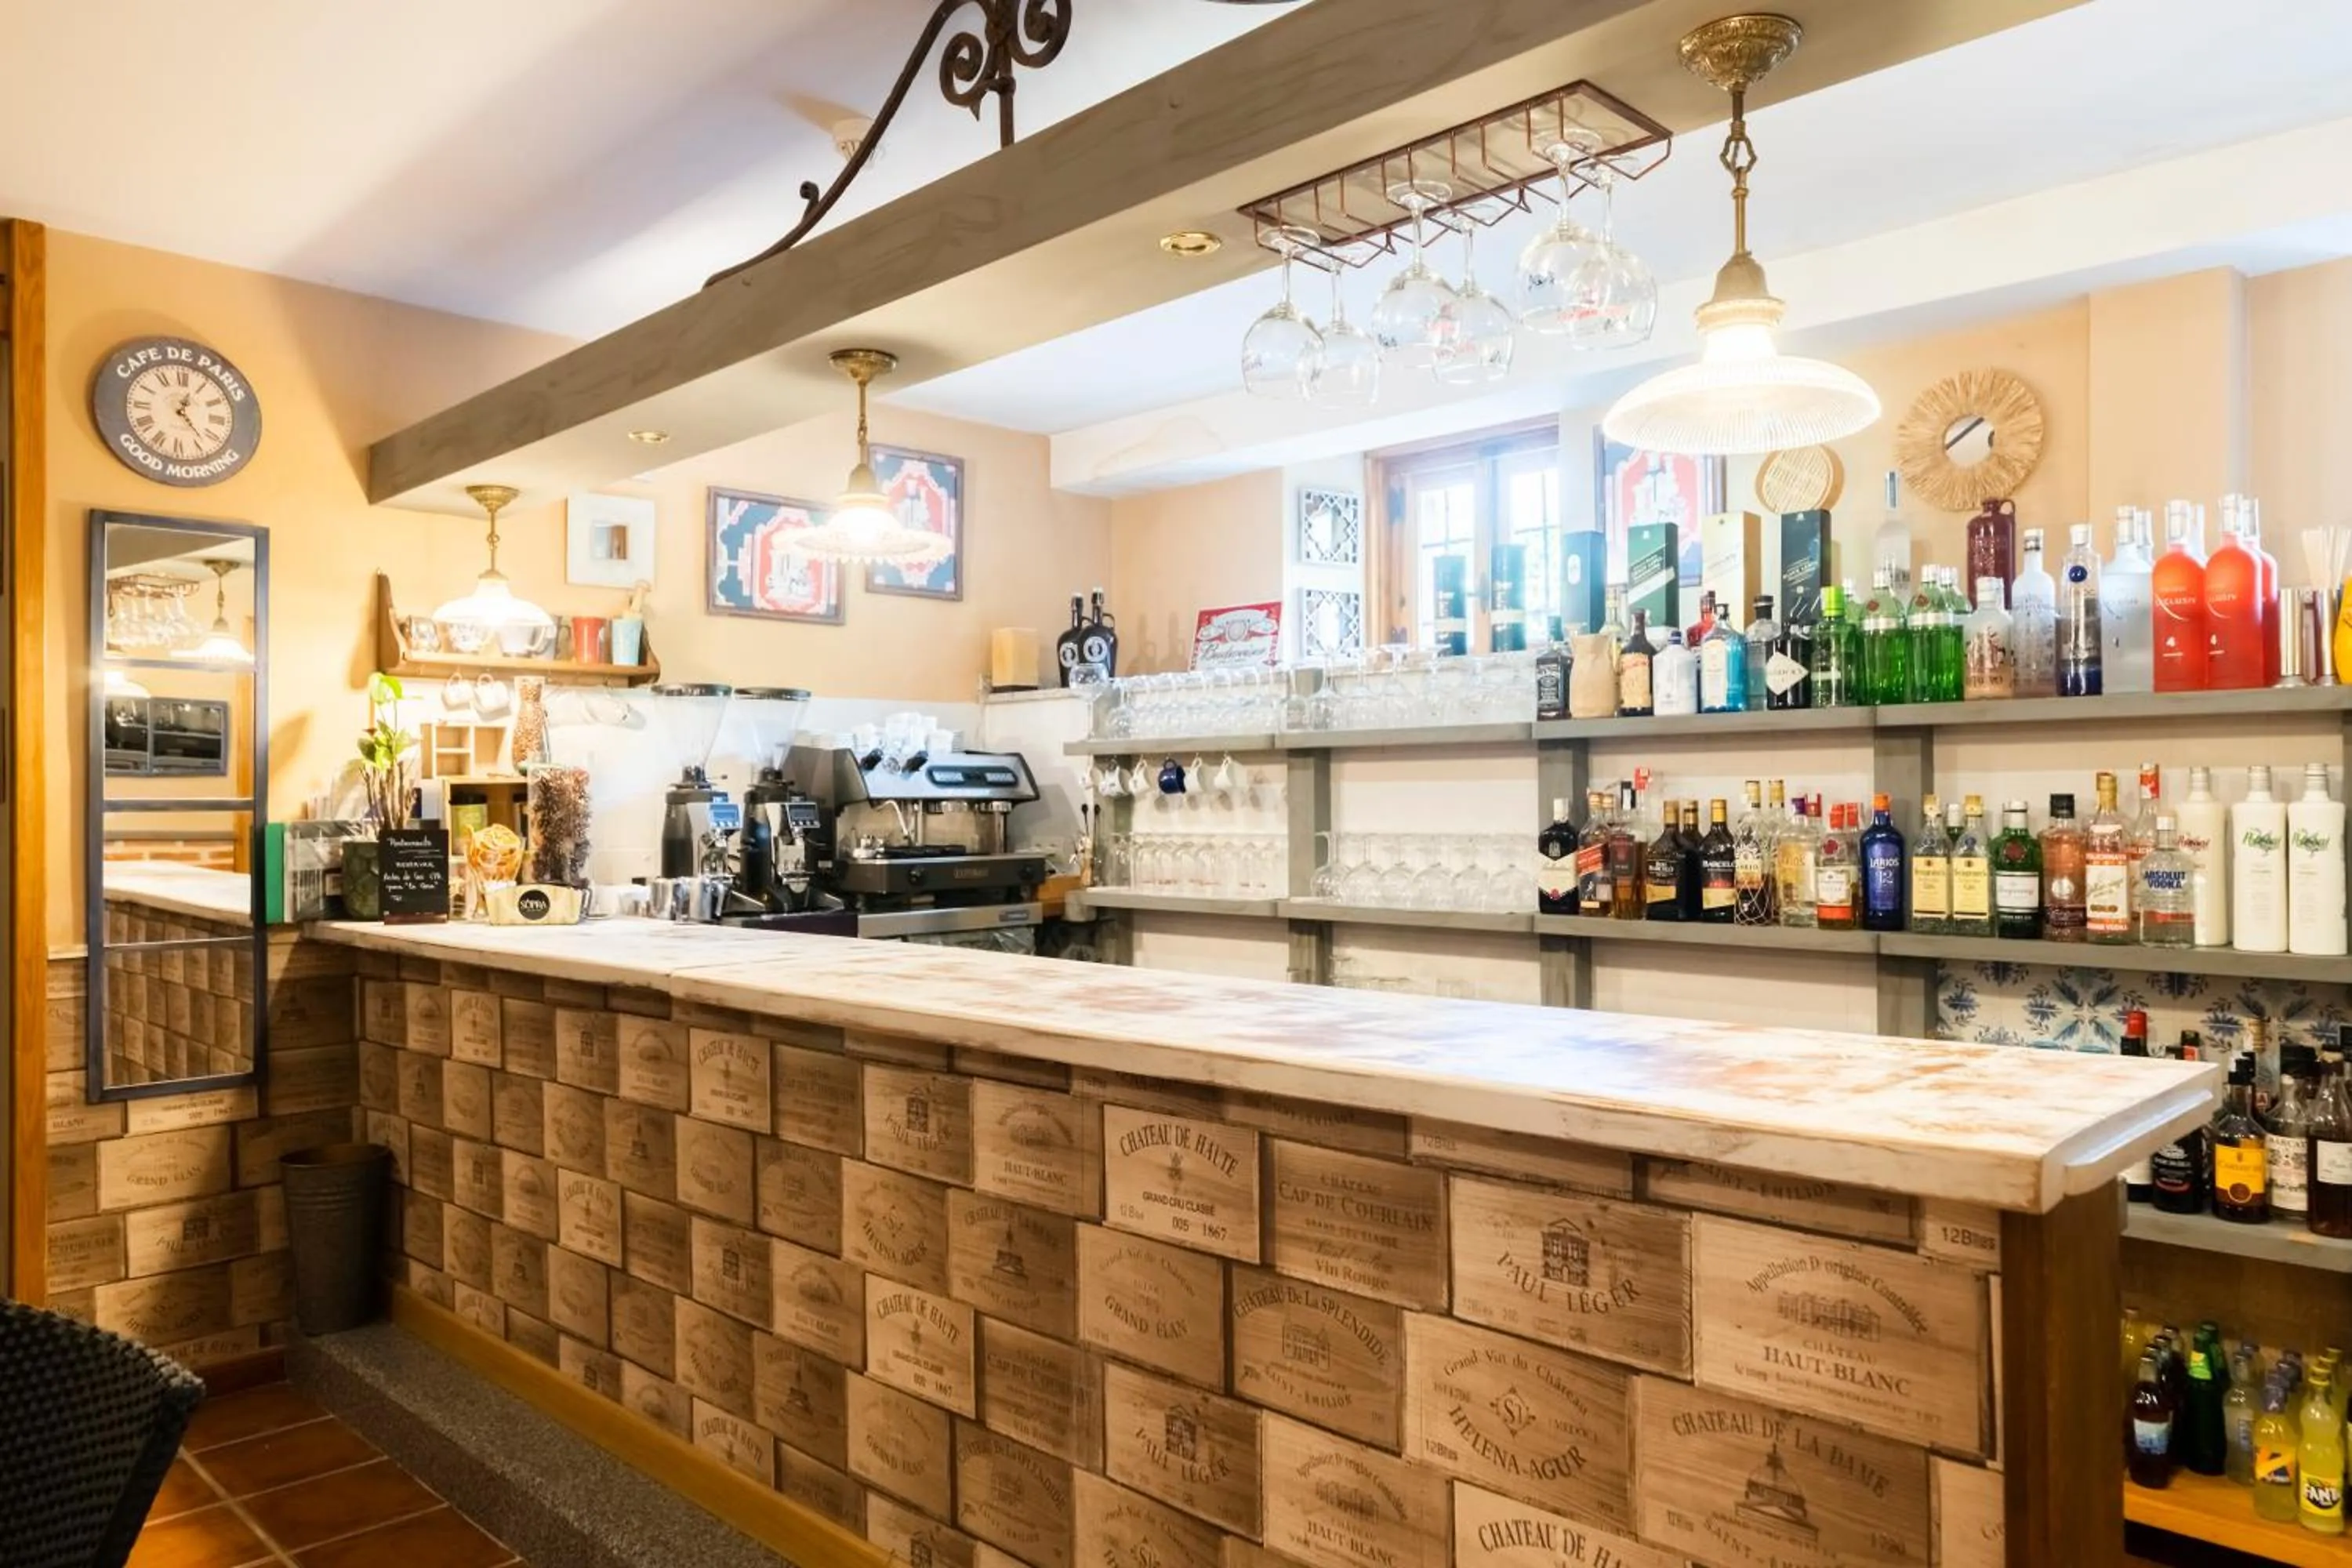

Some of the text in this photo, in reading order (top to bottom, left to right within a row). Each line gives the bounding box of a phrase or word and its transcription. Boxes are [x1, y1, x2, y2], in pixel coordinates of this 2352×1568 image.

[117, 346, 245, 401] CAFE DE PARIS
[119, 434, 239, 478] GOOD MORNING
[1869, 858, 1900, 869] LARIOS
[2143, 871, 2186, 880] ABSOLUT
[2147, 880, 2183, 889] VODKA
[1120, 1123, 1239, 1178] CHATEAU DE HAUTE
[1142, 1191, 1168, 1206] GRAND
[1278, 1180, 1311, 1203] CAP
[1315, 1192, 1334, 1210] DE
[1202, 1222, 1228, 1242] 1867
[1315, 1258, 1390, 1290] Vin Rouge
[1497, 1250, 1548, 1305] PAUL
[1745, 1258, 1806, 1294] Appellation
[1104, 1294, 1149, 1334] GRAND
[1320, 1296, 1392, 1366] SPLENDIDE
[1443, 1348, 1479, 1377] Grand
[1485, 1348, 1507, 1364] Vin
[1512, 1353, 1529, 1370] du
[1763, 1345, 1911, 1396] HAUT-BLANC
[1448, 1406, 1522, 1476] HELENA
[1528, 1444, 1588, 1481] AGUR
[1671, 1410, 1754, 1438] CHATEAU
[1762, 1418, 1787, 1445] DE
[1794, 1427, 1820, 1458] LA
[1477, 1517, 1557, 1554] CHATEAU
[1562, 1528, 1587, 1563] DE
